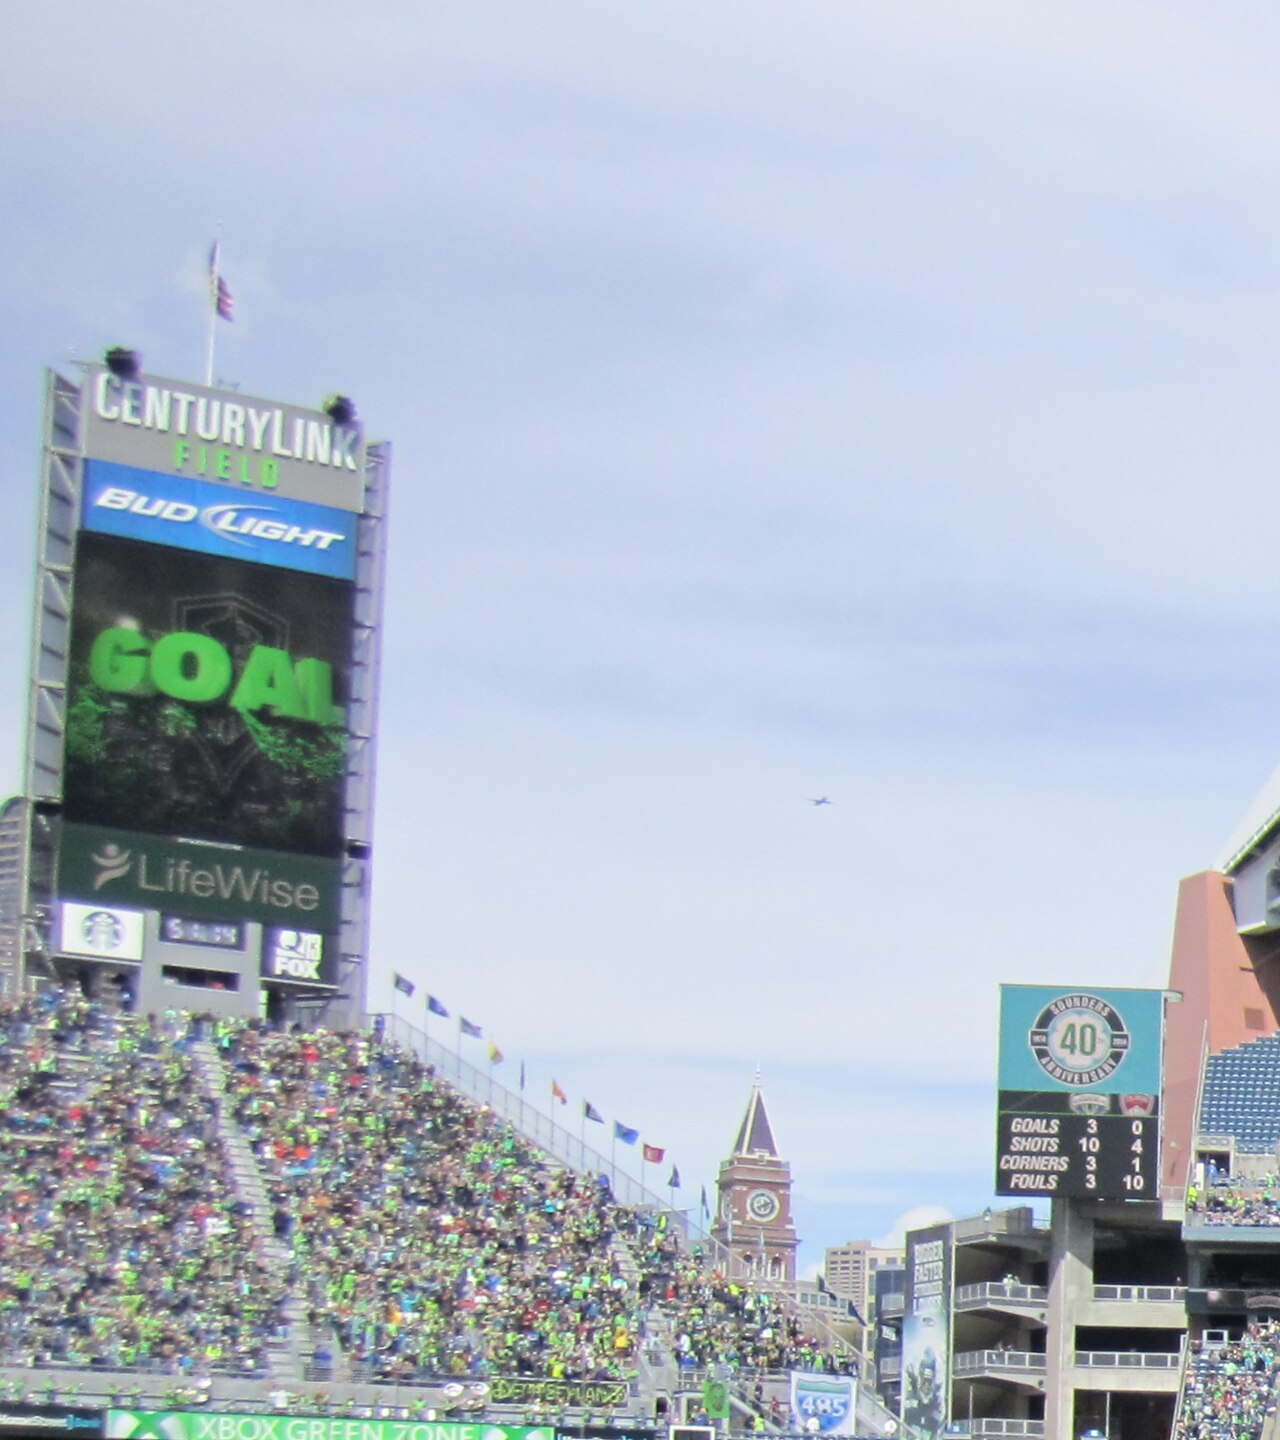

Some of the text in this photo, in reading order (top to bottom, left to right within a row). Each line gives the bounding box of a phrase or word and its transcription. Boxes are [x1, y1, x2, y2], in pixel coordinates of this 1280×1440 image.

[96, 372, 359, 472] CENTURYLINK
[174, 440, 281, 489] FIELD
[94, 486, 346, 551] BUD LIGHT
[88, 625, 337, 726] GOAL
[136, 852, 322, 912] LifeWise
[274, 956, 322, 980] FOX
[1048, 996, 1112, 1017] SOUNDERS
[1059, 1022, 1097, 1056] 40
[1039, 1056, 1117, 1084] ANNIVERSARY
[1010, 1117, 1143, 1135] GOALS 3 0
[1009, 1136, 1143, 1154] SHOTS 10 4
[1000, 1155, 1141, 1172] CORNERS 3 1
[1009, 1173, 1144, 1190] FOULS 3 10
[800, 1396, 846, 1418] 485
